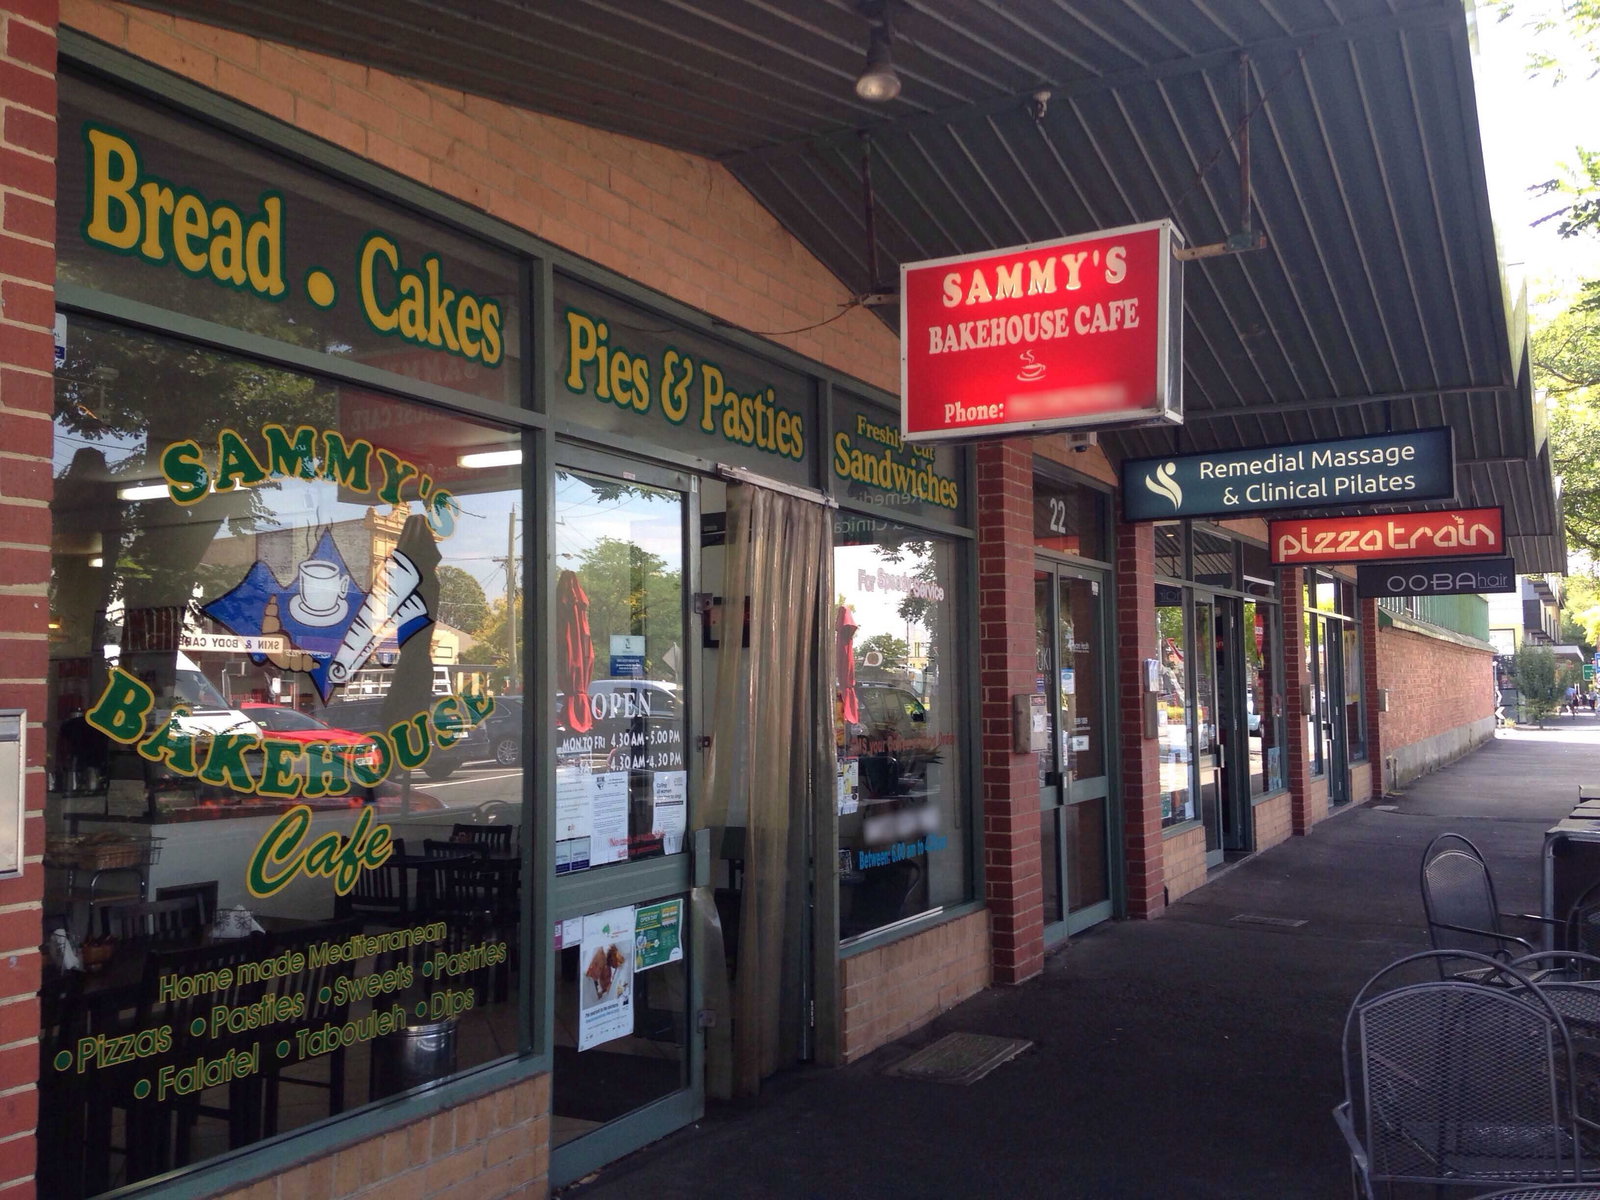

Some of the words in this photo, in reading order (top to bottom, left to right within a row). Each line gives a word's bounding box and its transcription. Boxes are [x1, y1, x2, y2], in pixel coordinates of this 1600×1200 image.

[86, 123, 287, 299] Bread
[358, 233, 502, 367] Cakes
[942, 245, 1128, 308] SAMMY'S
[928, 306, 1070, 355] BAKEHOUSE
[1073, 297, 1140, 336] CAFE
[566, 309, 651, 413] Pies
[660, 349, 694, 423] &
[700, 362, 804, 459] Pasties
[944, 401, 1005, 424] Phone:
[856, 414, 905, 453] Freshly
[1200, 450, 1304, 480] Remedial
[1311, 445, 1416, 470] Massage
[160, 424, 460, 540] SAMMY'S
[835, 432, 958, 509] Sandwiches
[1222, 486, 1239, 505] &
[1245, 478, 1327, 503] Clinical
[1334, 473, 1416, 496] Pilates
[1050, 497, 1066, 534] 22
[912, 580, 944, 601] Service
[85, 668, 495, 799] BAKEHOUSE
[591, 691, 653, 721] OPEN
[562, 738, 581, 752] MON
[594, 735, 606, 749] FRI
[610, 732, 630, 748] 4.30
[631, 731, 645, 747] AM
[650, 730, 668, 745] 5.00
[668, 729, 681, 744] PM
[610, 757, 631, 772] 4.30
[632, 755, 646, 769] AM
[670, 751, 682, 766] PM
[246, 805, 393, 899] Cafe
[159, 967, 233, 1003] Home
[237, 951, 305, 986] made
[309, 921, 448, 969] Mediterranean
[77, 1022, 172, 1074] Pizzas
[211, 991, 305, 1039] Pasties
[333, 962, 414, 1007] Sweets
[434, 940, 508, 980] Pastries
[157, 1042, 260, 1102] Falafel
[296, 1005, 407, 1061] Tabouleh
[430, 985, 475, 1021] Dips
